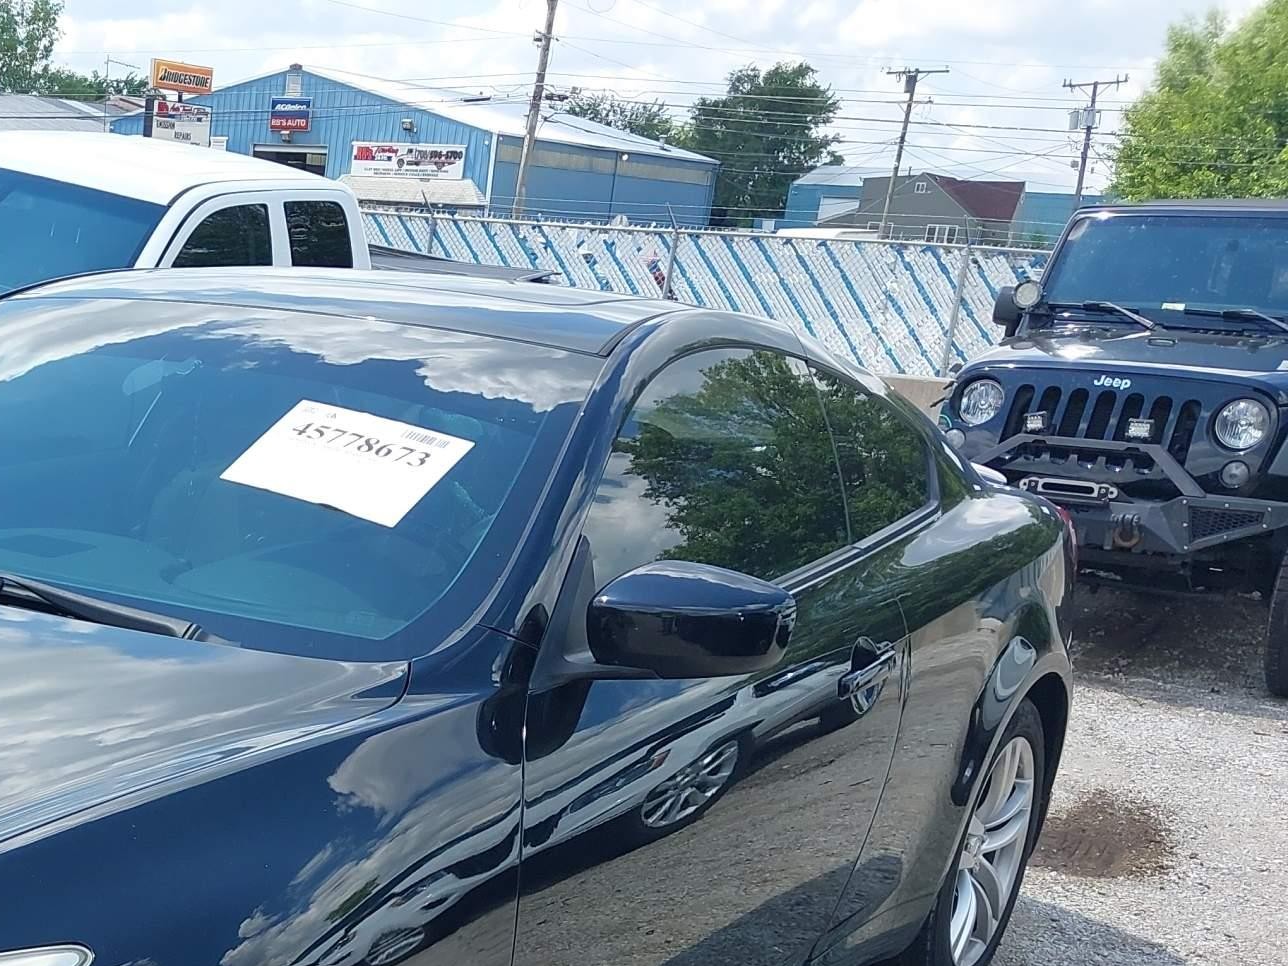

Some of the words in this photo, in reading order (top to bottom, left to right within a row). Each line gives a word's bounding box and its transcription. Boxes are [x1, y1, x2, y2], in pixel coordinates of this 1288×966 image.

[159, 68, 211, 88] BRIDGESTONE
[286, 119, 306, 127] AUTO
[1093, 374, 1131, 390] Jeep
[292, 422, 431, 467] 45778673
